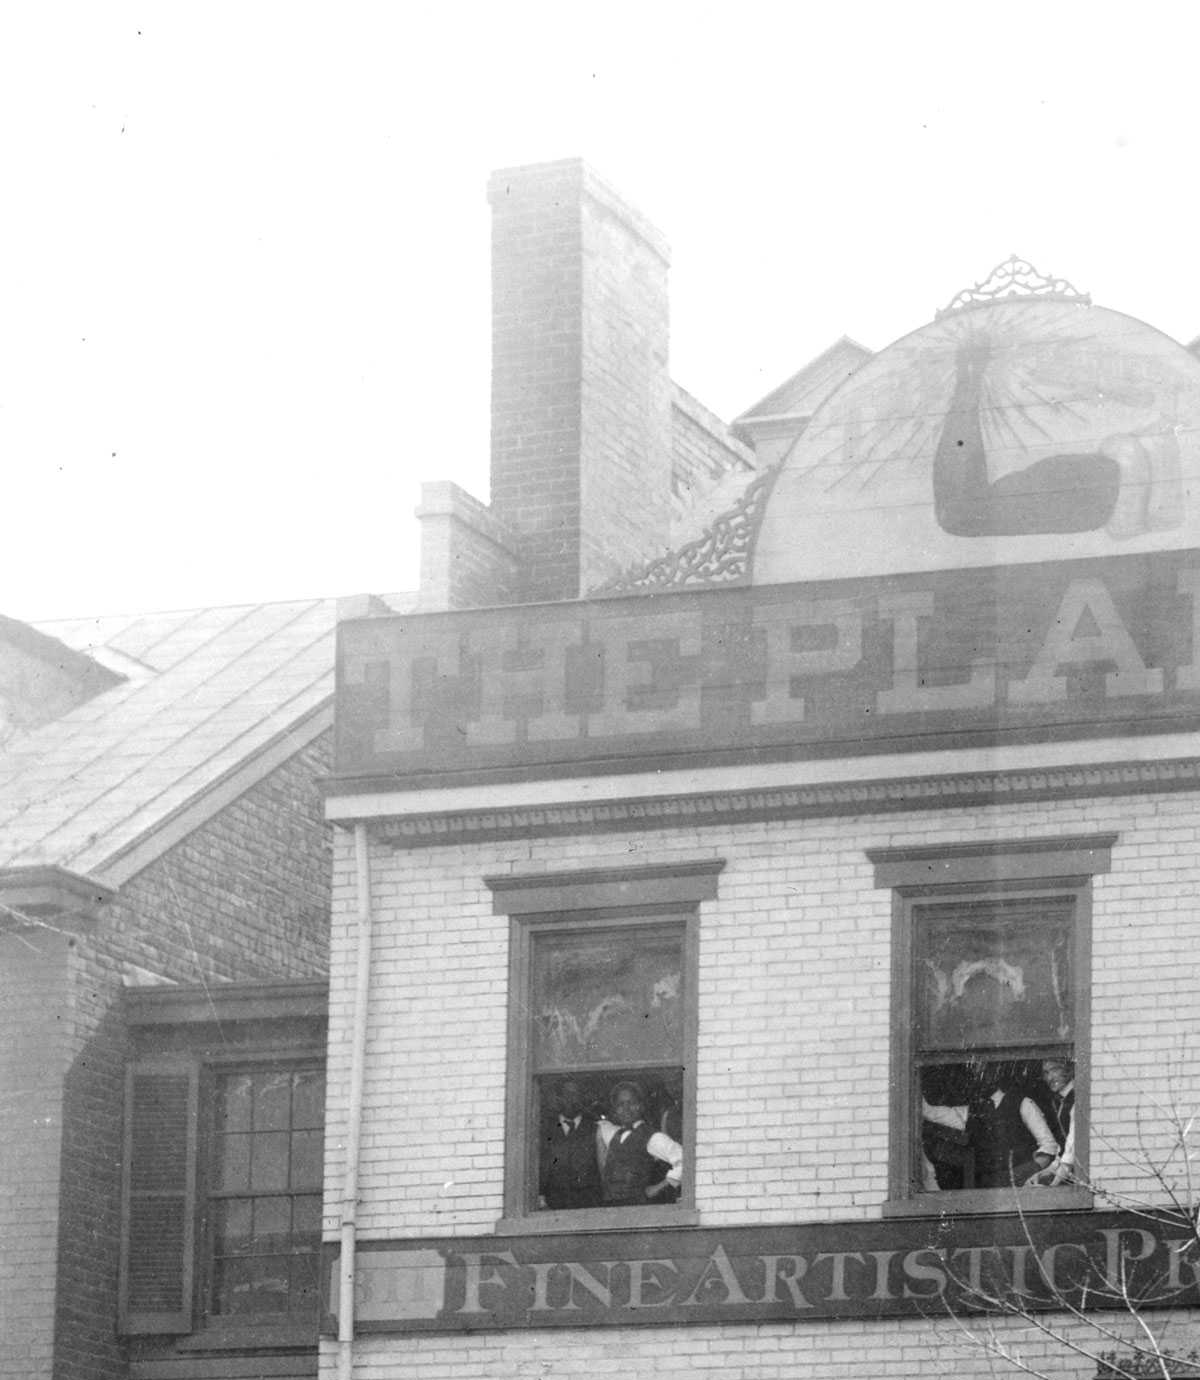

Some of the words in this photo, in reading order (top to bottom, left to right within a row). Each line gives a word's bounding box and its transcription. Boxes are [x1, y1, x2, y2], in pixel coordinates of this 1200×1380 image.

[344, 610, 702, 752] THE
[456, 1249, 680, 1313] FINE
[684, 1242, 1088, 1310] ARTISTIC
